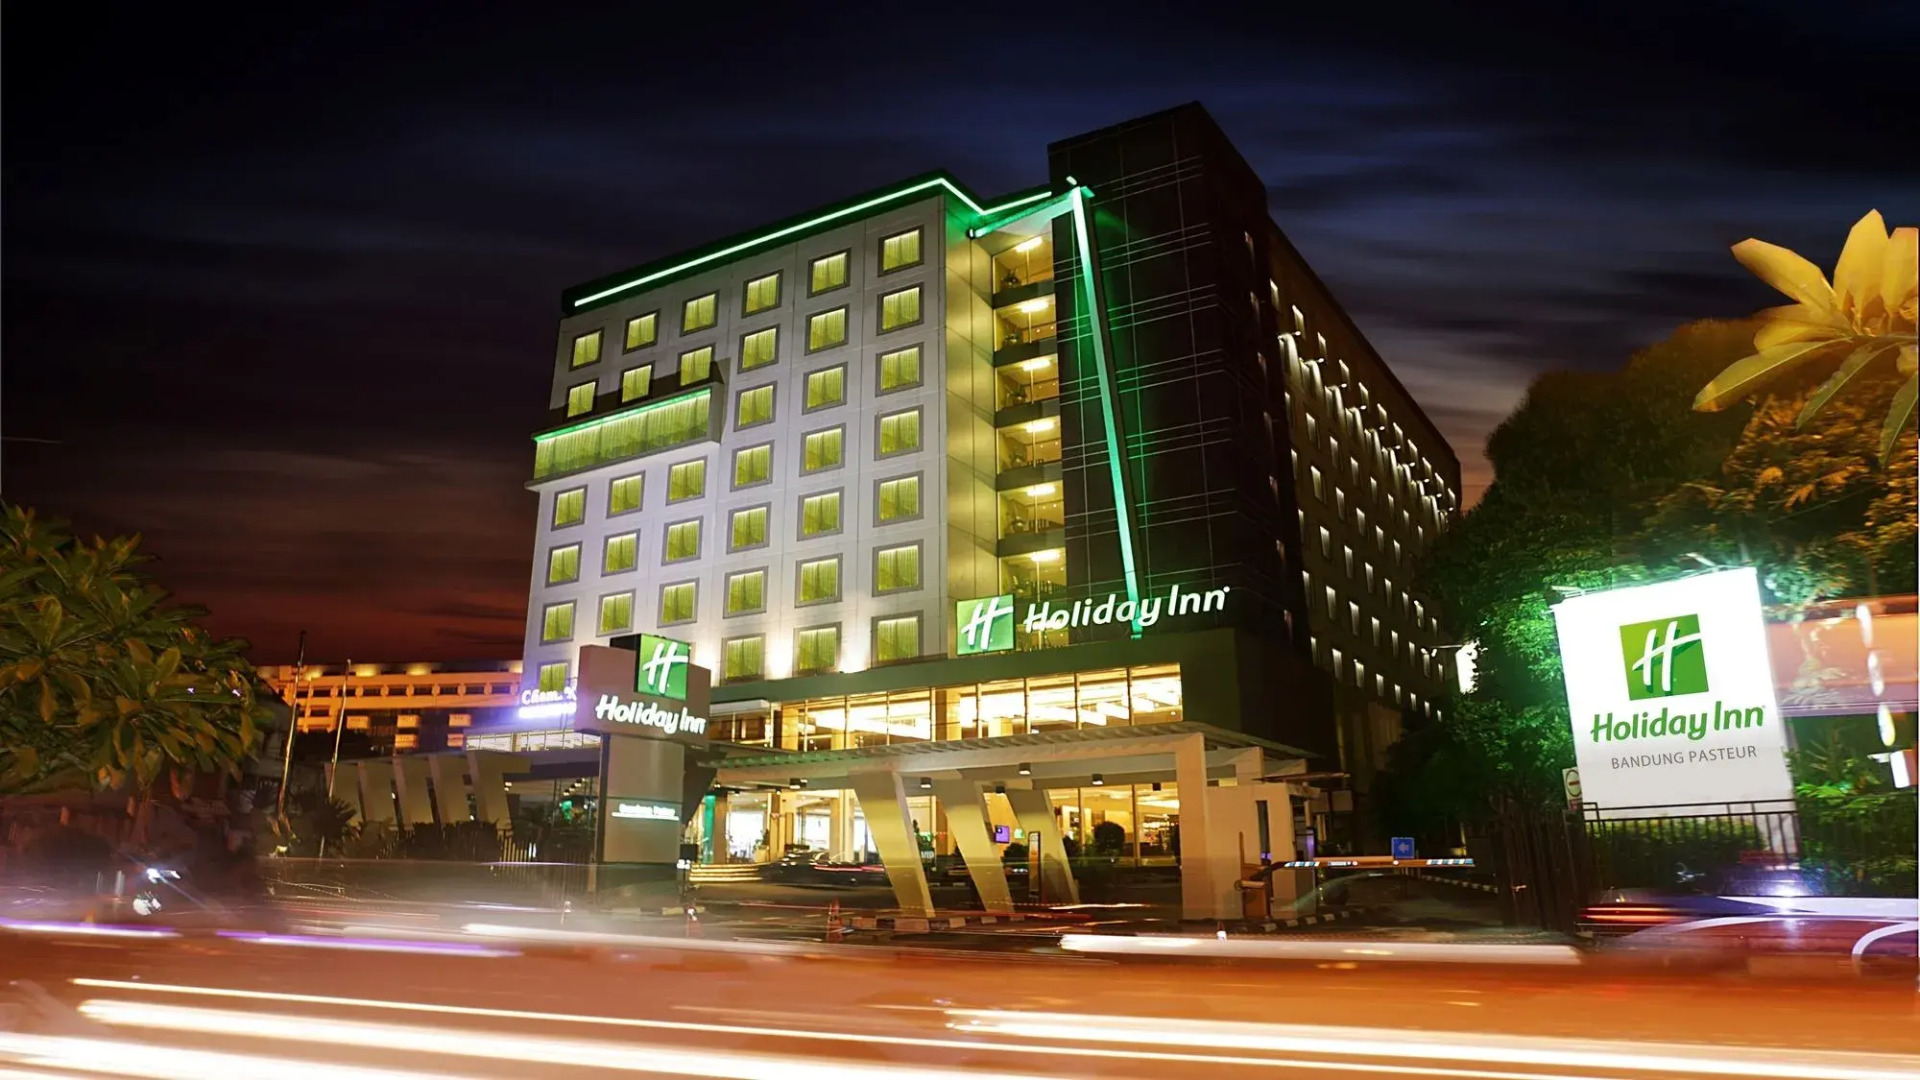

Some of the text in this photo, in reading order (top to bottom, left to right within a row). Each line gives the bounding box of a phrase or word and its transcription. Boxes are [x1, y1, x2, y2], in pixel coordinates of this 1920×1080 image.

[1023, 584, 1226, 633] Holiday Inn
[595, 694, 680, 734] Holiday
[679, 706, 707, 735] Inn
[1590, 701, 1764, 741] Holiday Inn
[1611, 745, 1758, 770] BANDUNG PASTEUR
